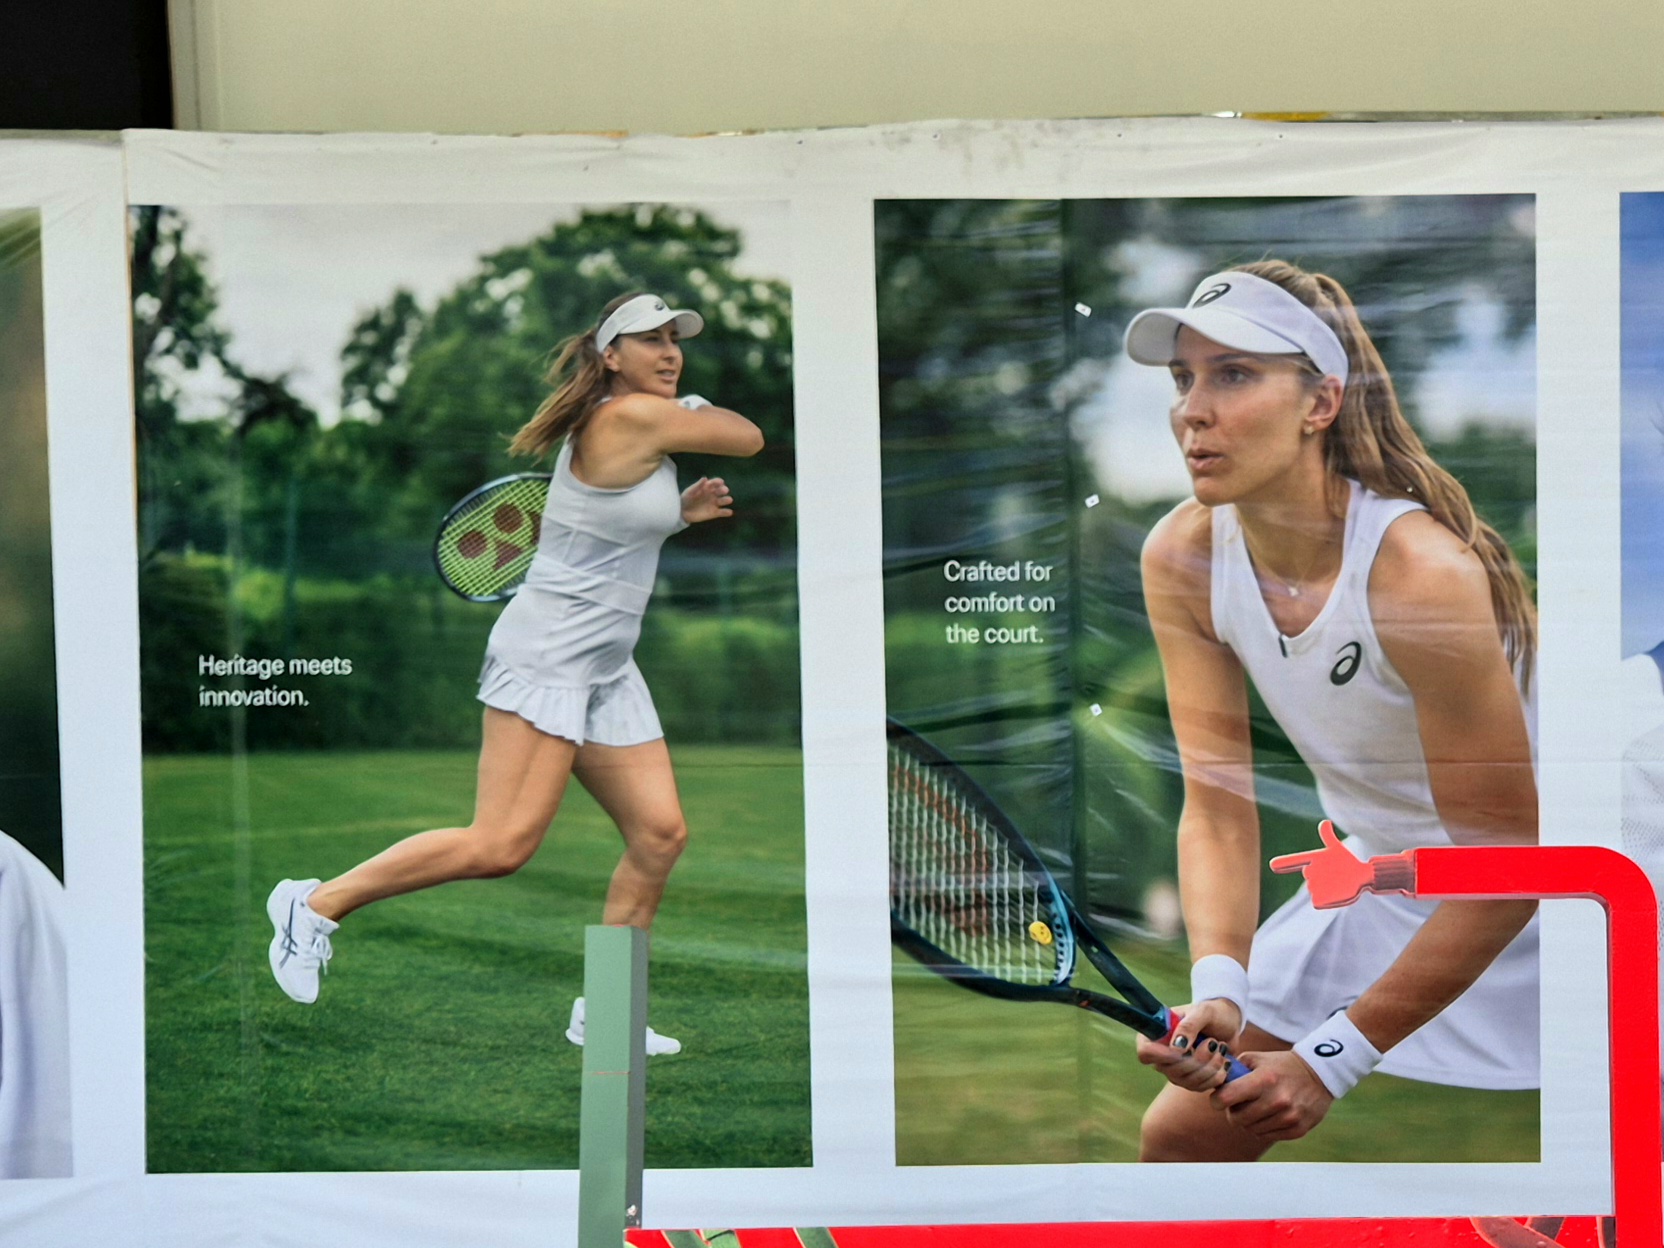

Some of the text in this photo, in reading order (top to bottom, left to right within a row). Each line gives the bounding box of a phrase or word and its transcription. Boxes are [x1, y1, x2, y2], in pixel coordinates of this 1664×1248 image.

[944, 560, 1053, 581] Crafted for
[944, 591, 1056, 613] comfort on
[945, 622, 1044, 644] the court.
[199, 653, 353, 681] Heritage meets
[199, 685, 310, 707] innovation.
